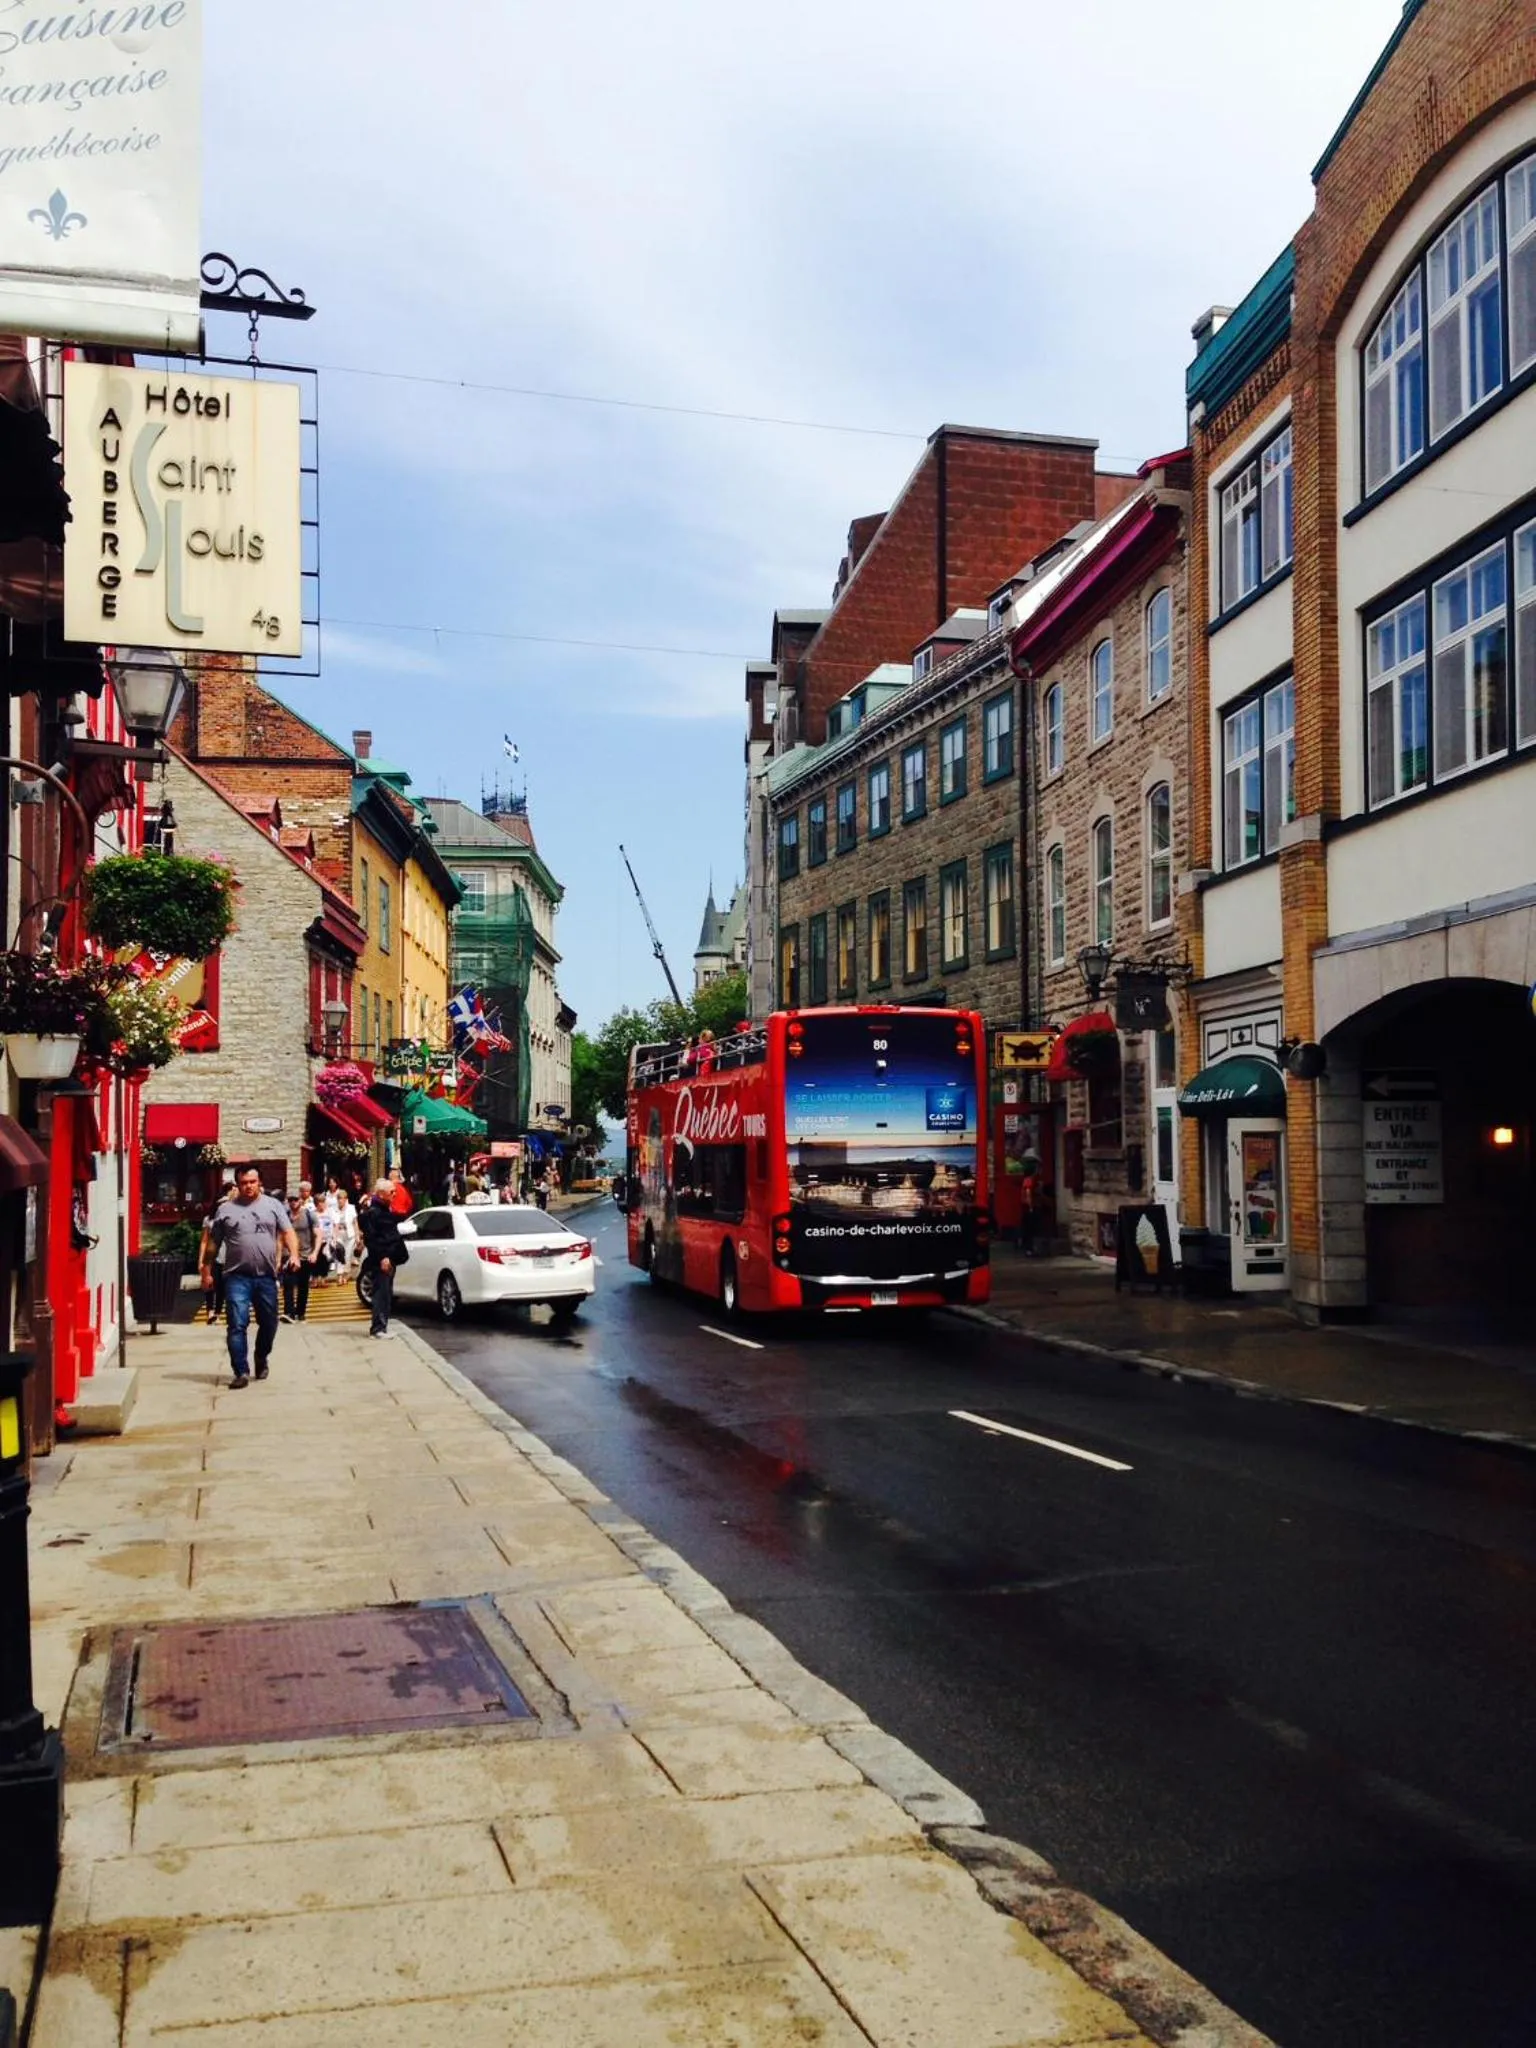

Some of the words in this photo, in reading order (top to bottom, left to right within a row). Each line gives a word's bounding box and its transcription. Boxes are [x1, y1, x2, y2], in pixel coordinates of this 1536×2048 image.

[145, 383, 231, 419] Hôtel
[98, 407, 122, 618] AUBERGE
[251, 607, 281, 637] 48
[873, 1039, 888, 1050] 80
[671, 1085, 739, 1160] Québec
[742, 1113, 766, 1136] TOURS
[929, 1113, 964, 1121] CASINO
[1390, 1124, 1413, 1138] VIA
[1376, 1158, 1429, 1169] ENTRANCE
[805, 1223, 962, 1237] casino-de-charlevoix.com
